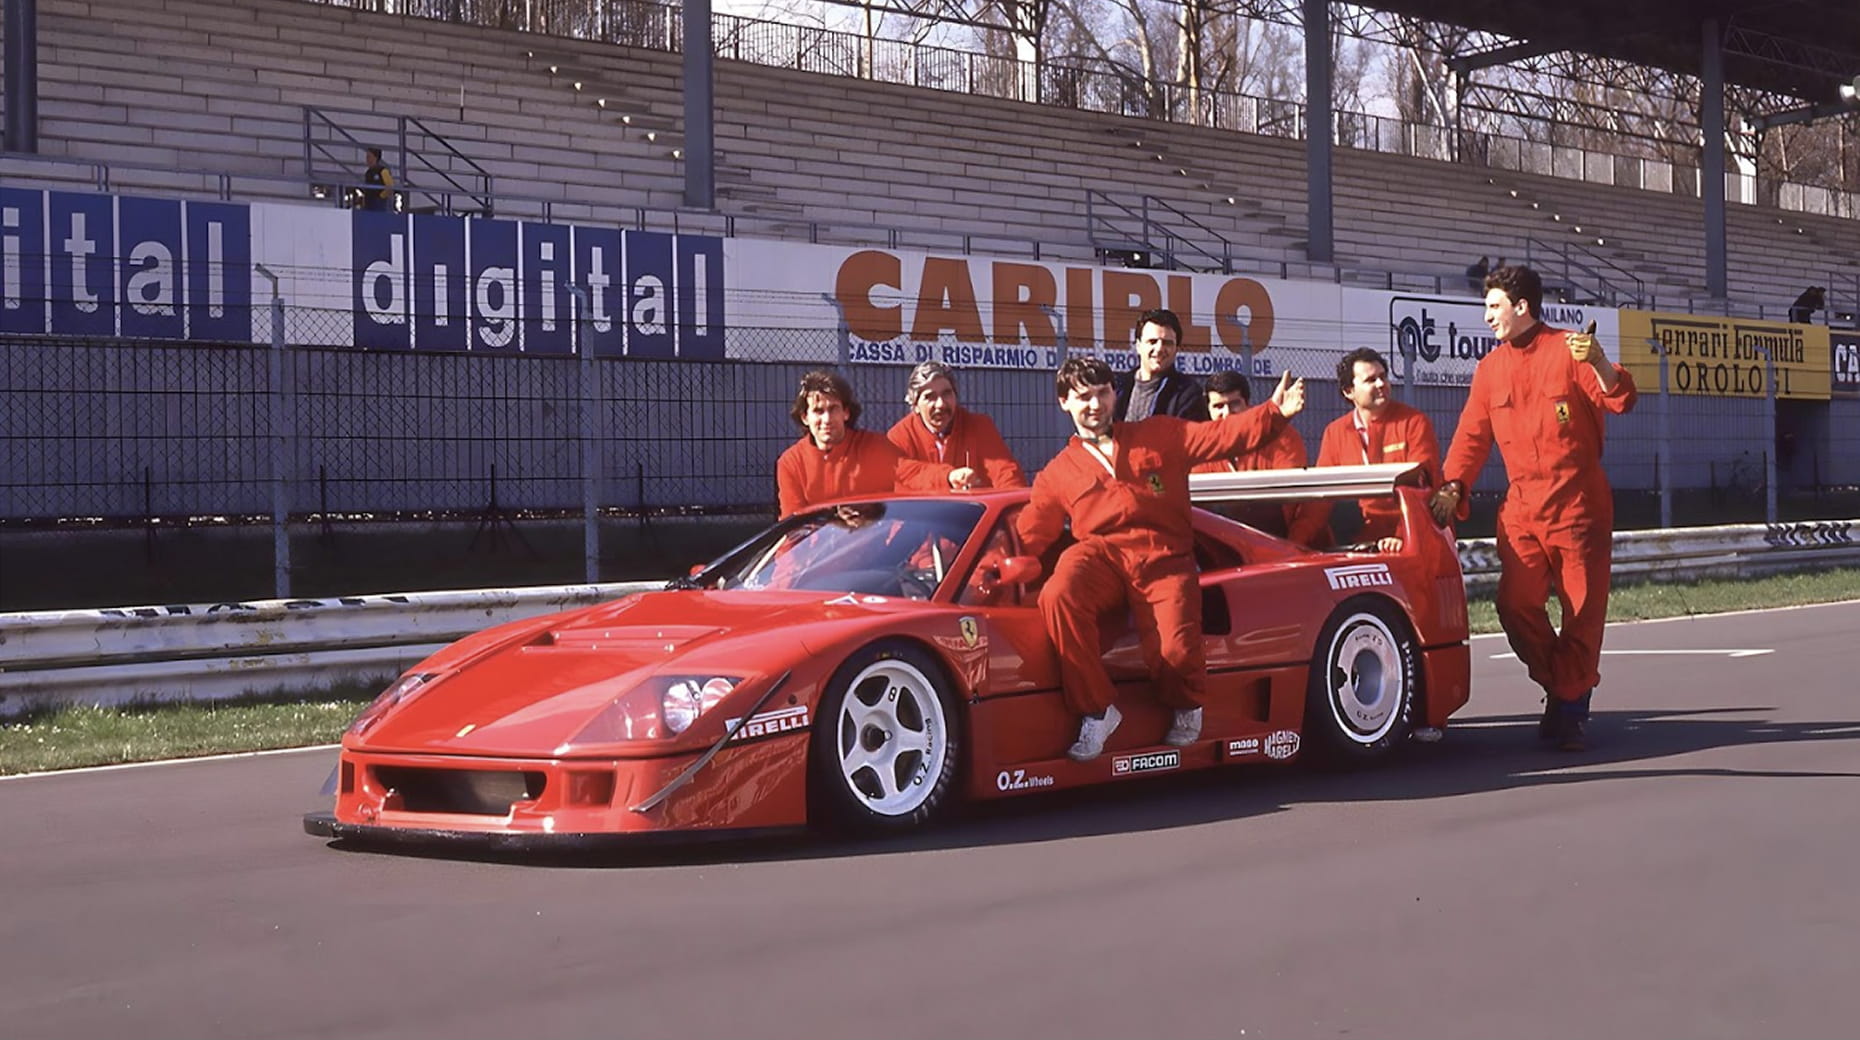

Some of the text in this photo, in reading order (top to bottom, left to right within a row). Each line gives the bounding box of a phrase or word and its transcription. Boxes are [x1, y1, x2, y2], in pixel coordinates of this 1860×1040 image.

[3, 207, 224, 319] ital
[836, 250, 1275, 355] CARIPLO
[1541, 306, 1583, 325] MILANO
[916, 345, 933, 362] DI
[943, 345, 1037, 366] RISPARMIO
[1194, 353, 1272, 375] LOMBADE
[1323, 563, 1393, 590] PIRELLI
[725, 705, 809, 740] PIRELLI
[1132, 753, 1177, 770] FACOM
